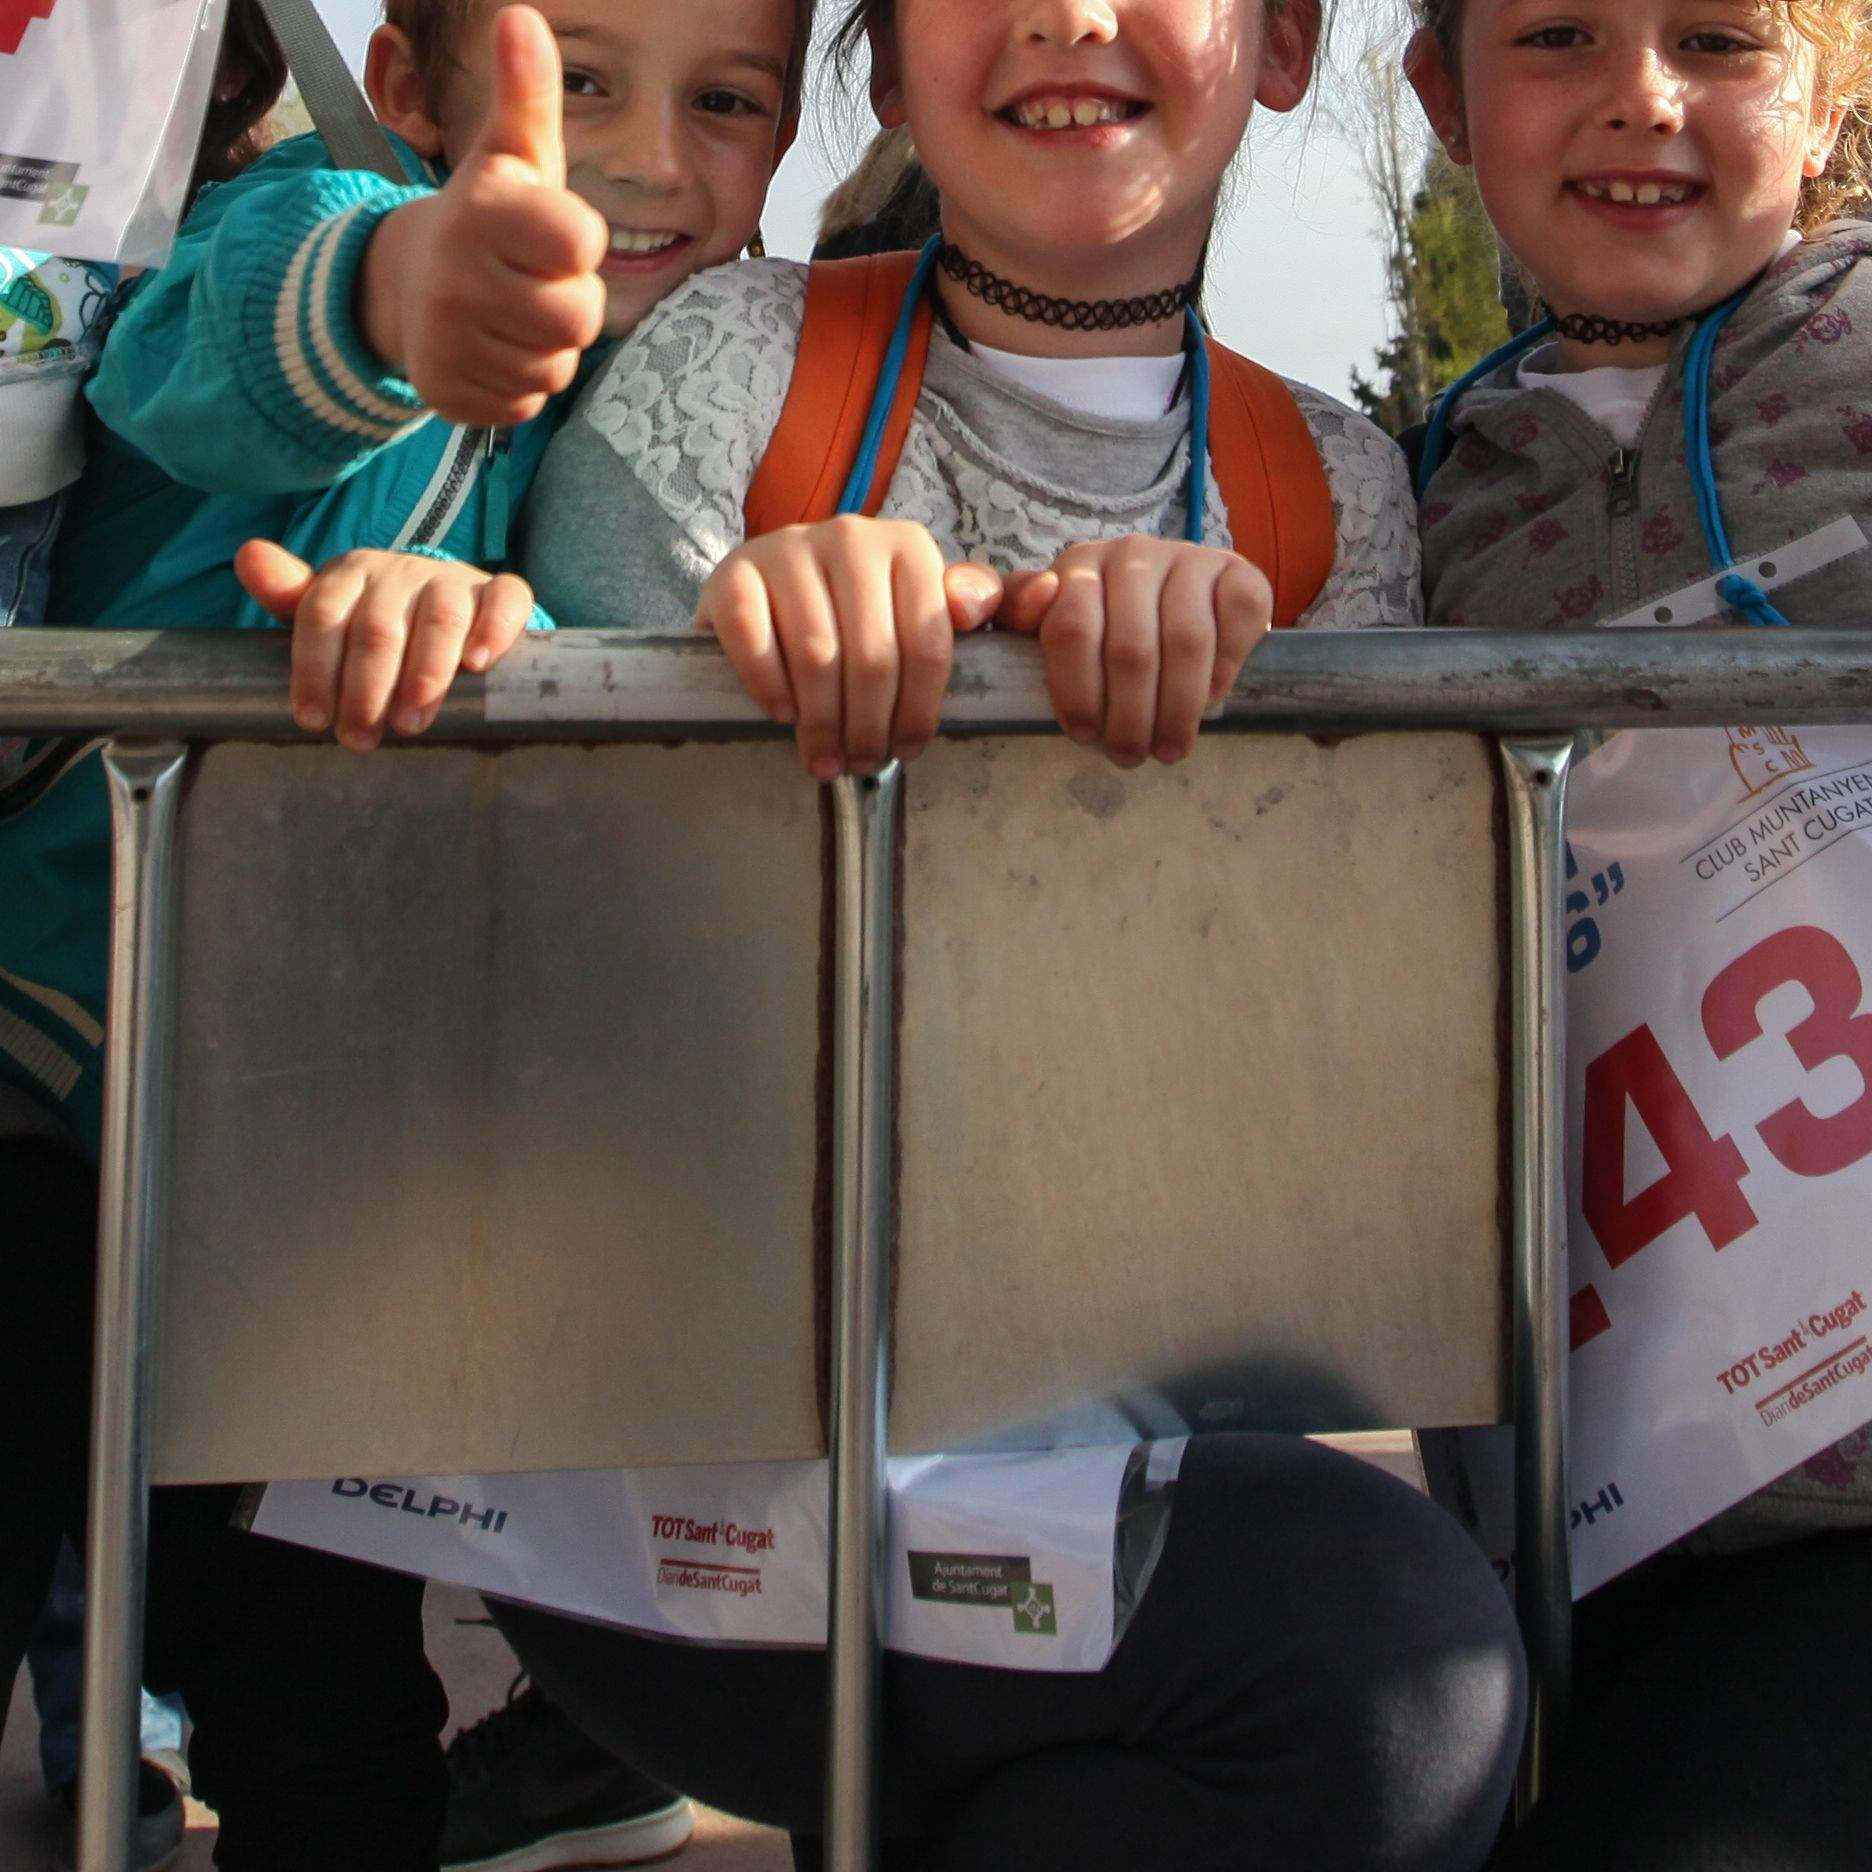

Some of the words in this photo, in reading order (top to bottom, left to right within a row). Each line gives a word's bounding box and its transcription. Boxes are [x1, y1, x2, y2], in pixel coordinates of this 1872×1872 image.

[1695, 837, 1746, 880] CLUB
[1744, 831, 1800, 882] SANT
[1716, 1349, 1760, 1395] TOT
[1758, 1329, 1808, 1367] Sant
[1809, 1289, 1868, 1339] Cugat
[331, 1478, 508, 1534] DELPHI
[652, 1515, 685, 1539] TOT
[685, 1521, 719, 1545] Sant
[726, 1524, 775, 1554] Cugat
[932, 1580, 946, 1593] de
[934, 1561, 1003, 1578] Ajuntament
